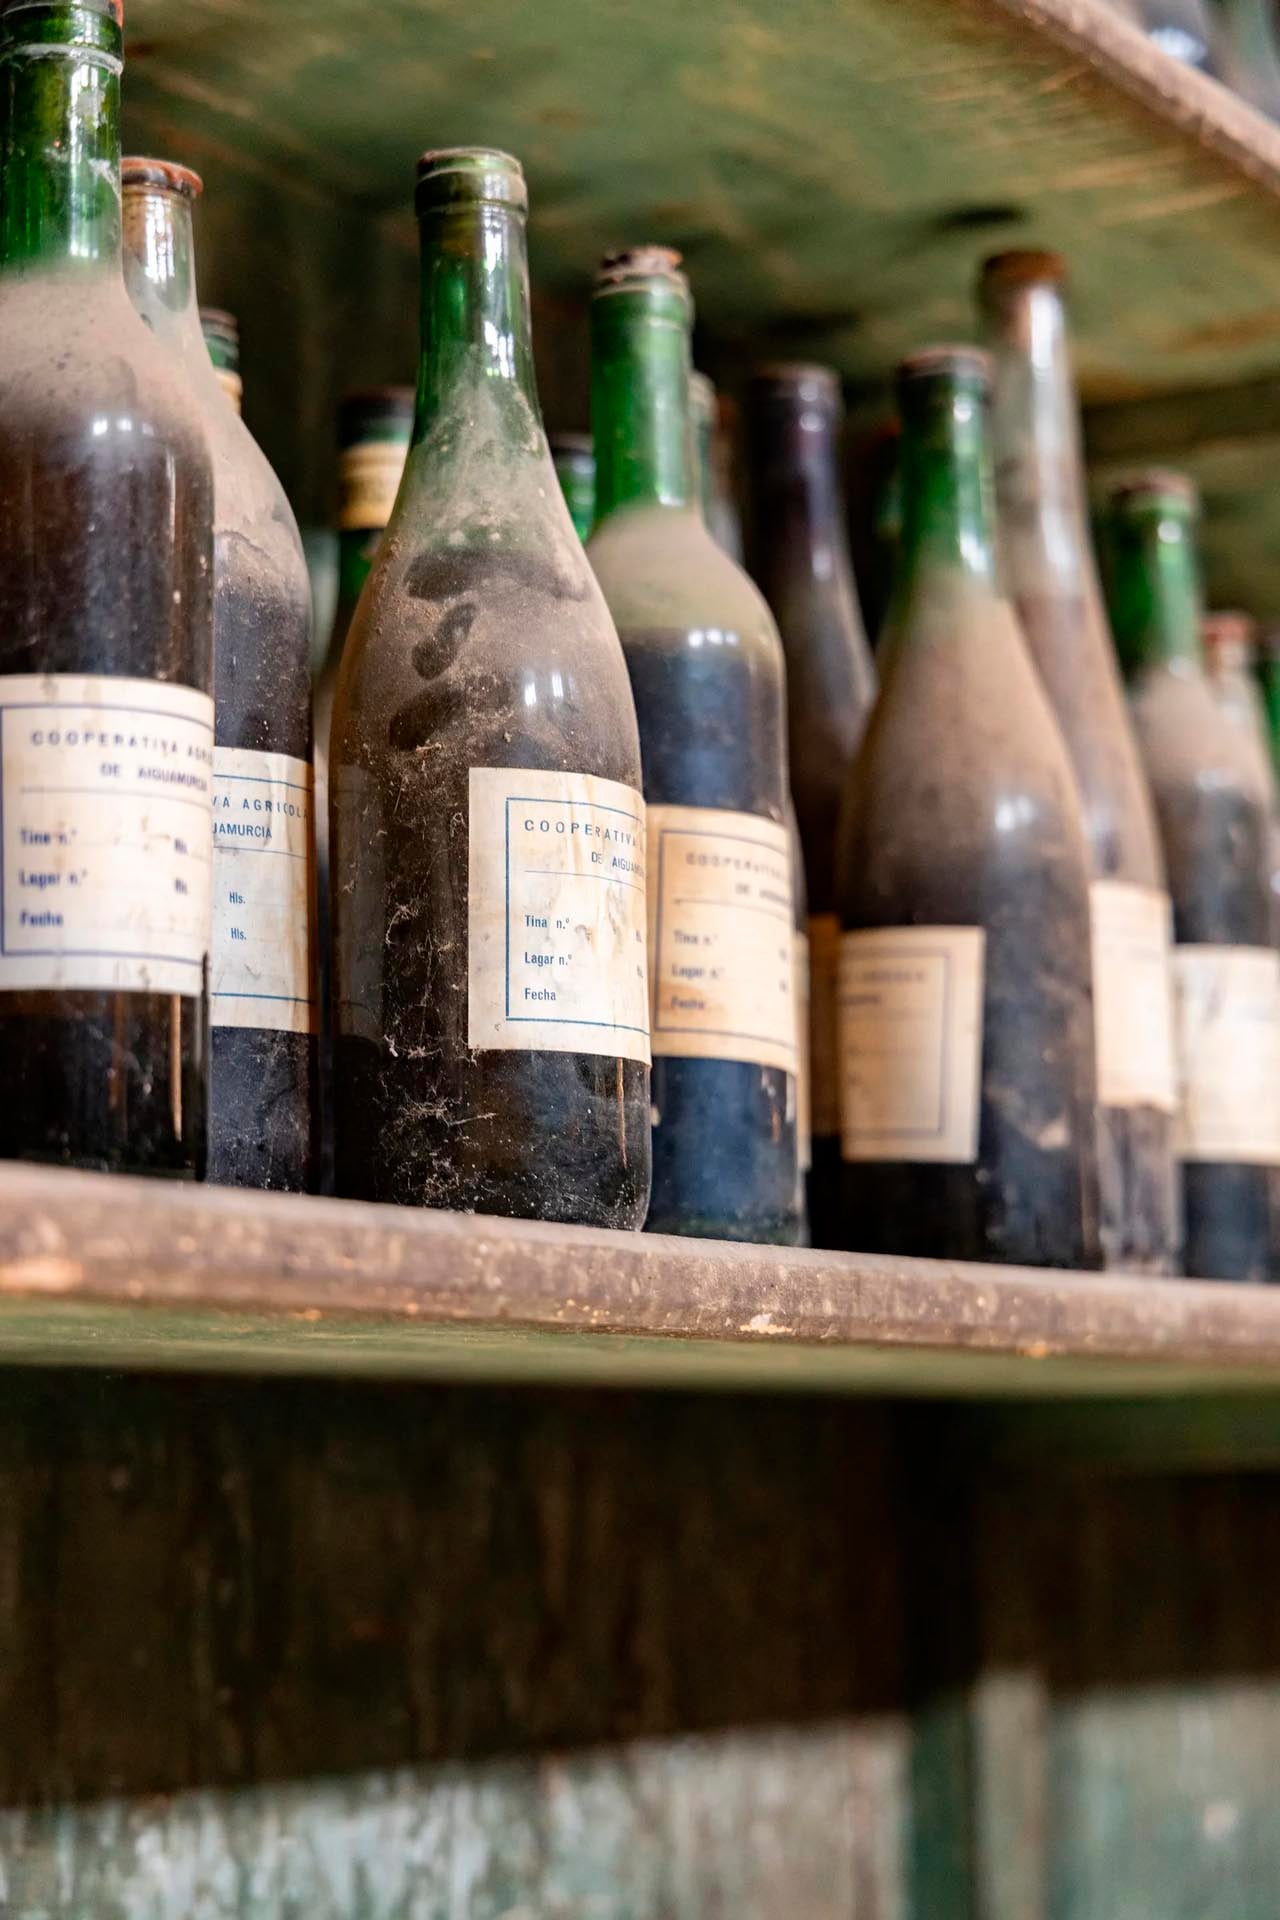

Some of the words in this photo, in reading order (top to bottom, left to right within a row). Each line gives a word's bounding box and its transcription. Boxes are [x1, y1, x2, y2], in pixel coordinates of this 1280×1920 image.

[524, 818, 637, 847] COOPERATIVA
[591, 851, 603, 865] DE
[524, 914, 548, 929] Tina
[524, 951, 555, 968] Lagar
[524, 987, 557, 1001] Fecha
